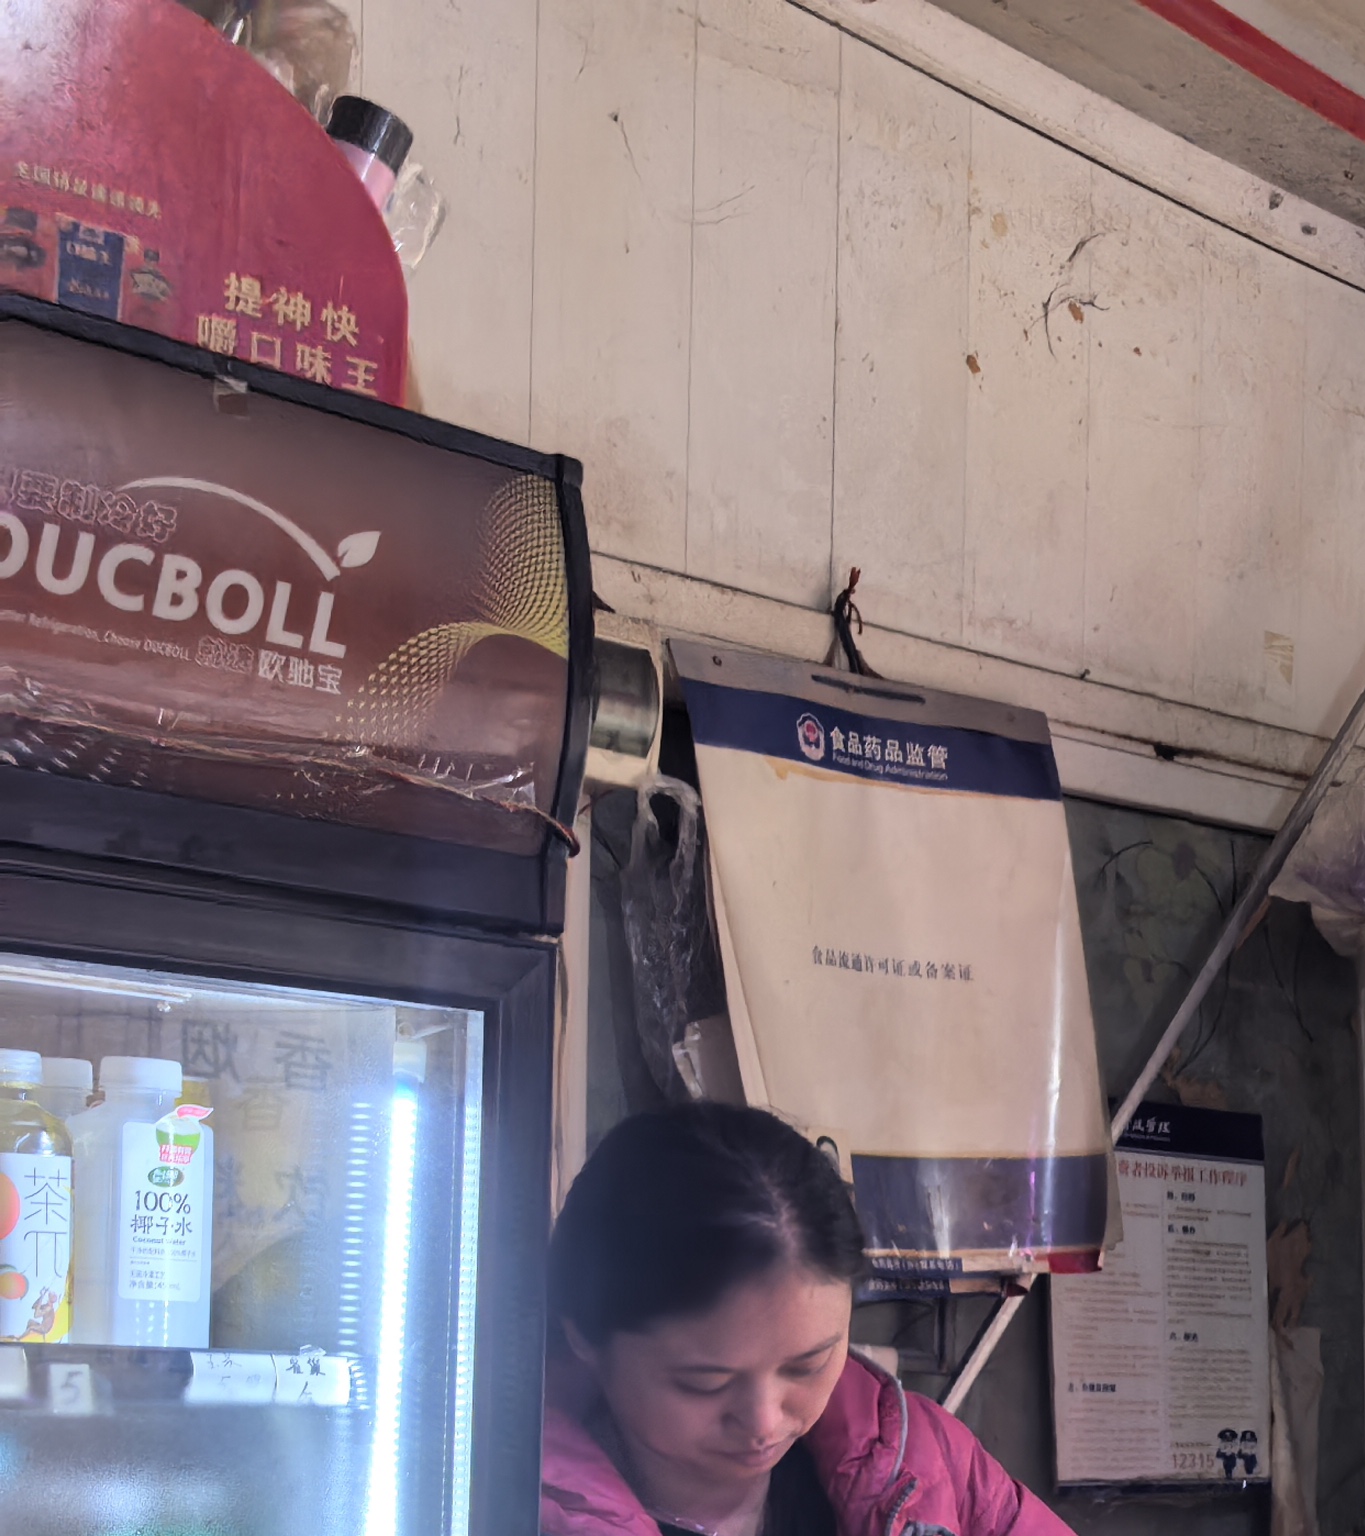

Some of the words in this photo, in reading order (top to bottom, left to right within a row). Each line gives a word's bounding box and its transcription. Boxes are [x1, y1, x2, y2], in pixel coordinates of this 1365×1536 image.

[224, 271, 359, 346] 提神快
[830, 726, 949, 770] 食品药品监管
[135, 1190, 191, 1215] 100%
